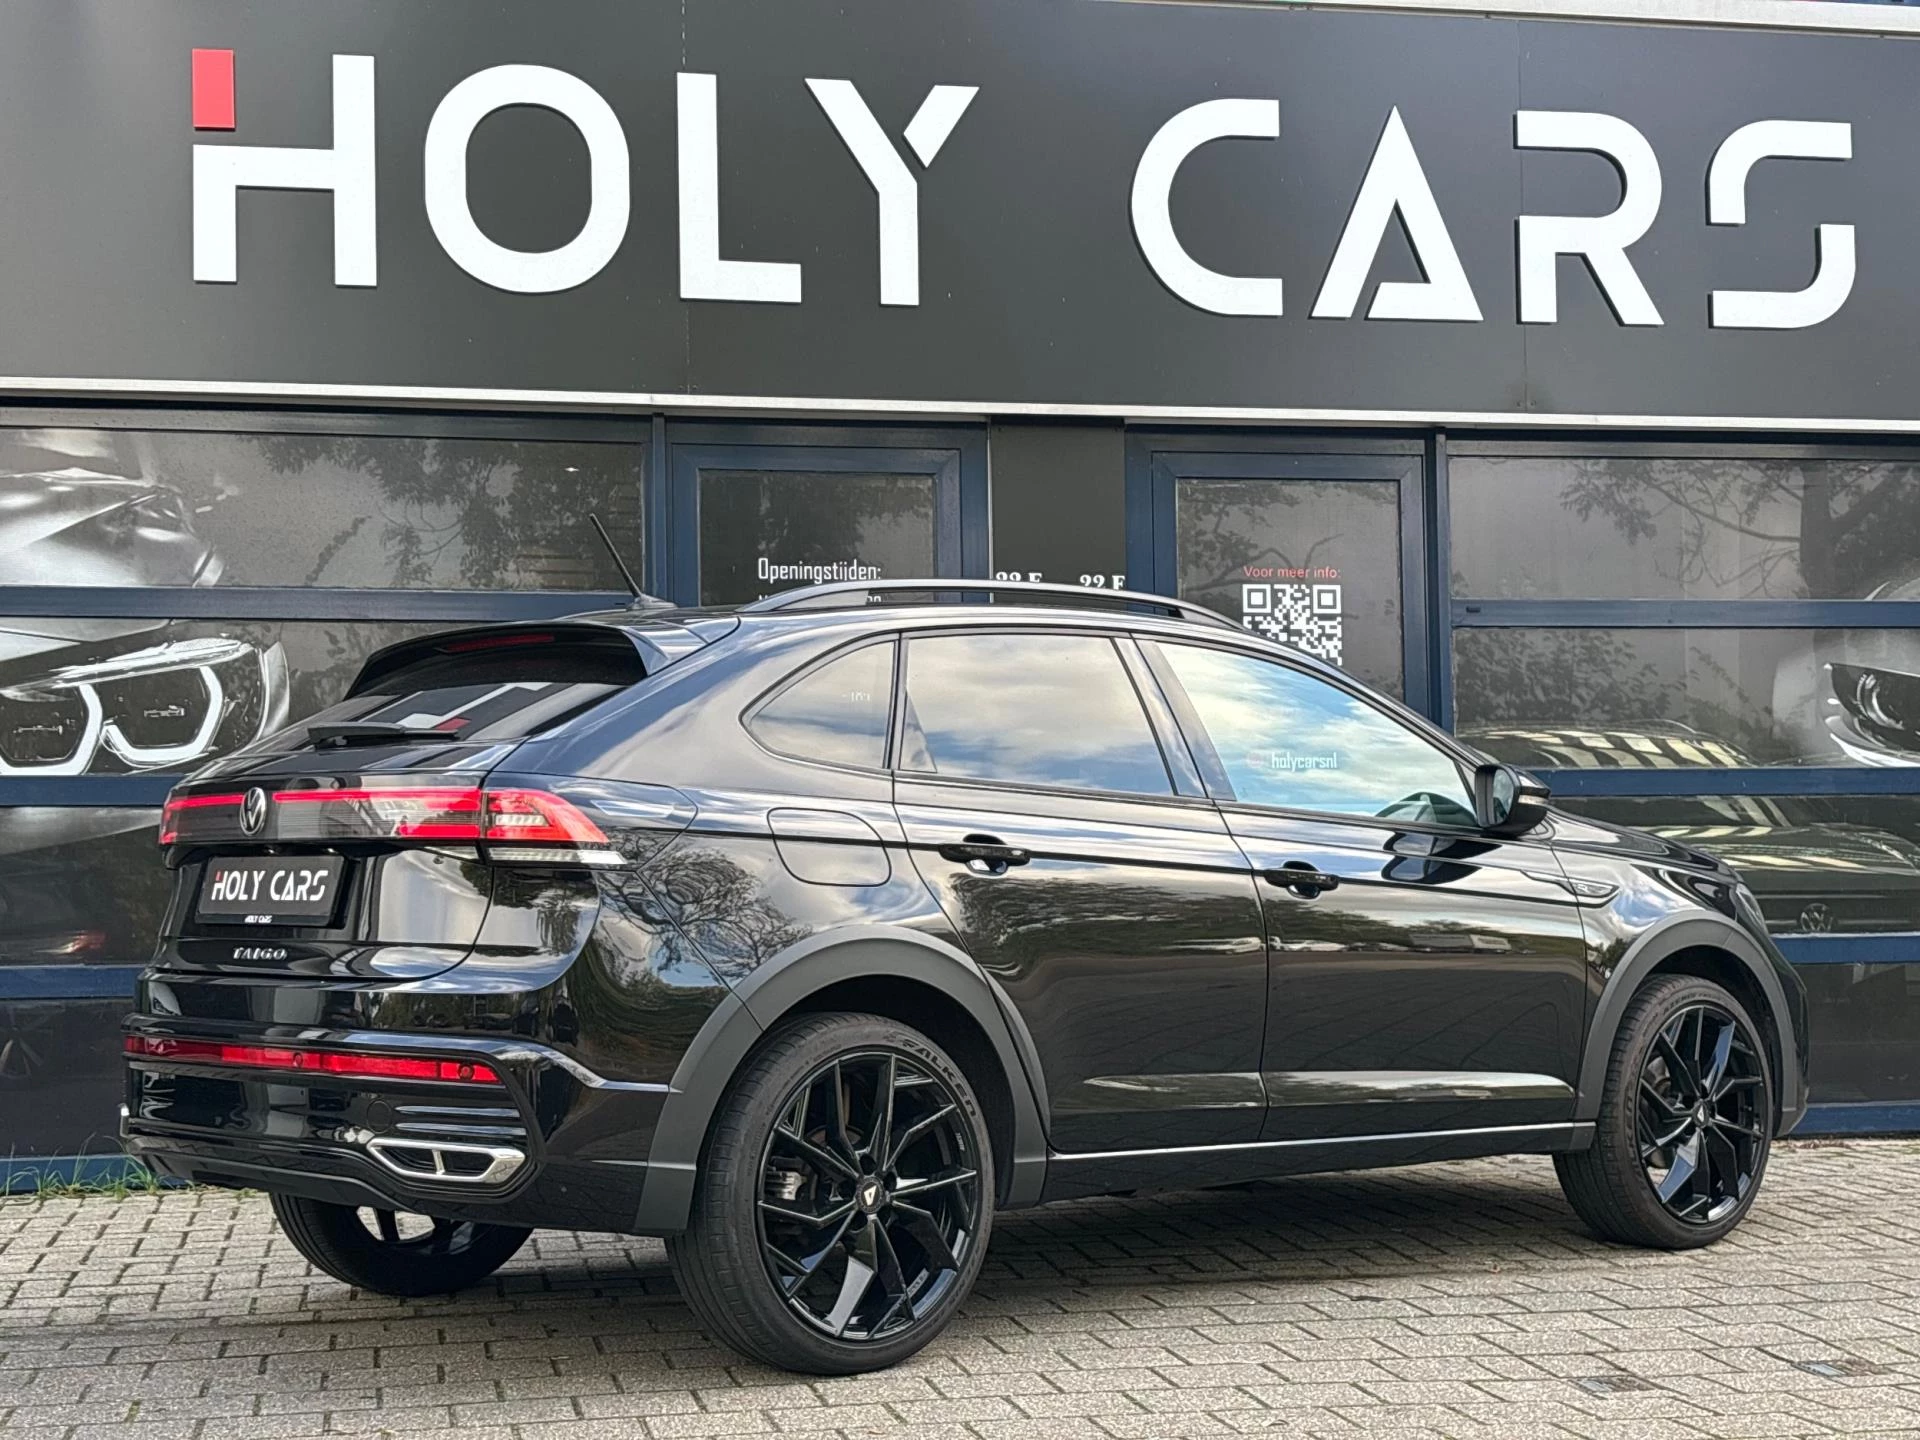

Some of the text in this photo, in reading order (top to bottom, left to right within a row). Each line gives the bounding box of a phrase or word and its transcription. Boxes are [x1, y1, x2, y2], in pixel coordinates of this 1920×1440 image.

[192, 49, 1856, 329] HOLY CARS
[758, 557, 882, 584] Openingstijden:
[1243, 566, 1342, 578] Voor meer info:
[1271, 751, 1338, 773] holycarsnl
[211, 869, 329, 902] HOLY CARS
[233, 946, 288, 960] TAIGO
